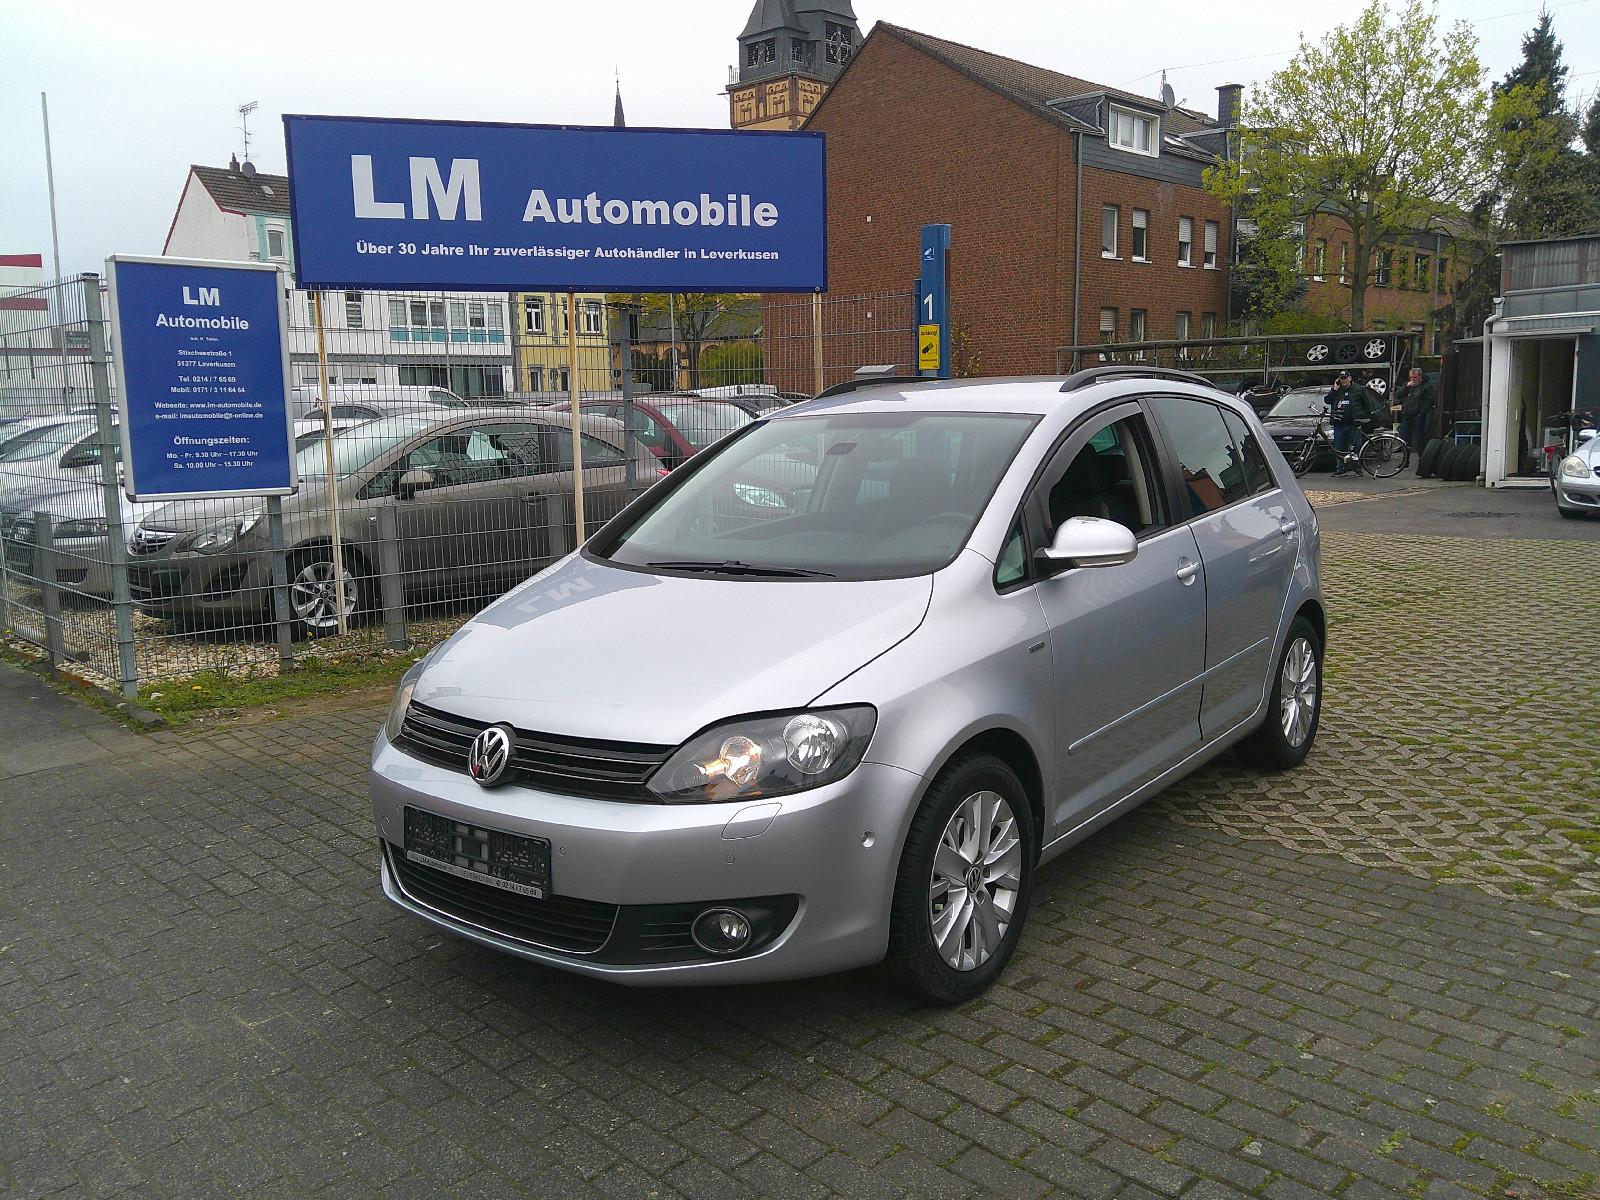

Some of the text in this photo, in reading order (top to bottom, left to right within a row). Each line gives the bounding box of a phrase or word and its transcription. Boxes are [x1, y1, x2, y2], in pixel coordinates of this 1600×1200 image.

[351, 154, 778, 226] LM Automobile
[356, 240, 779, 260] Über 30 Jahre Ihr zuverlässiger Autohändler in Leverkusen
[182, 286, 220, 306] LM
[924, 293, 934, 321] 1
[156, 314, 249, 330] Automobile
[174, 435, 250, 446] Öffnungszeiten:
